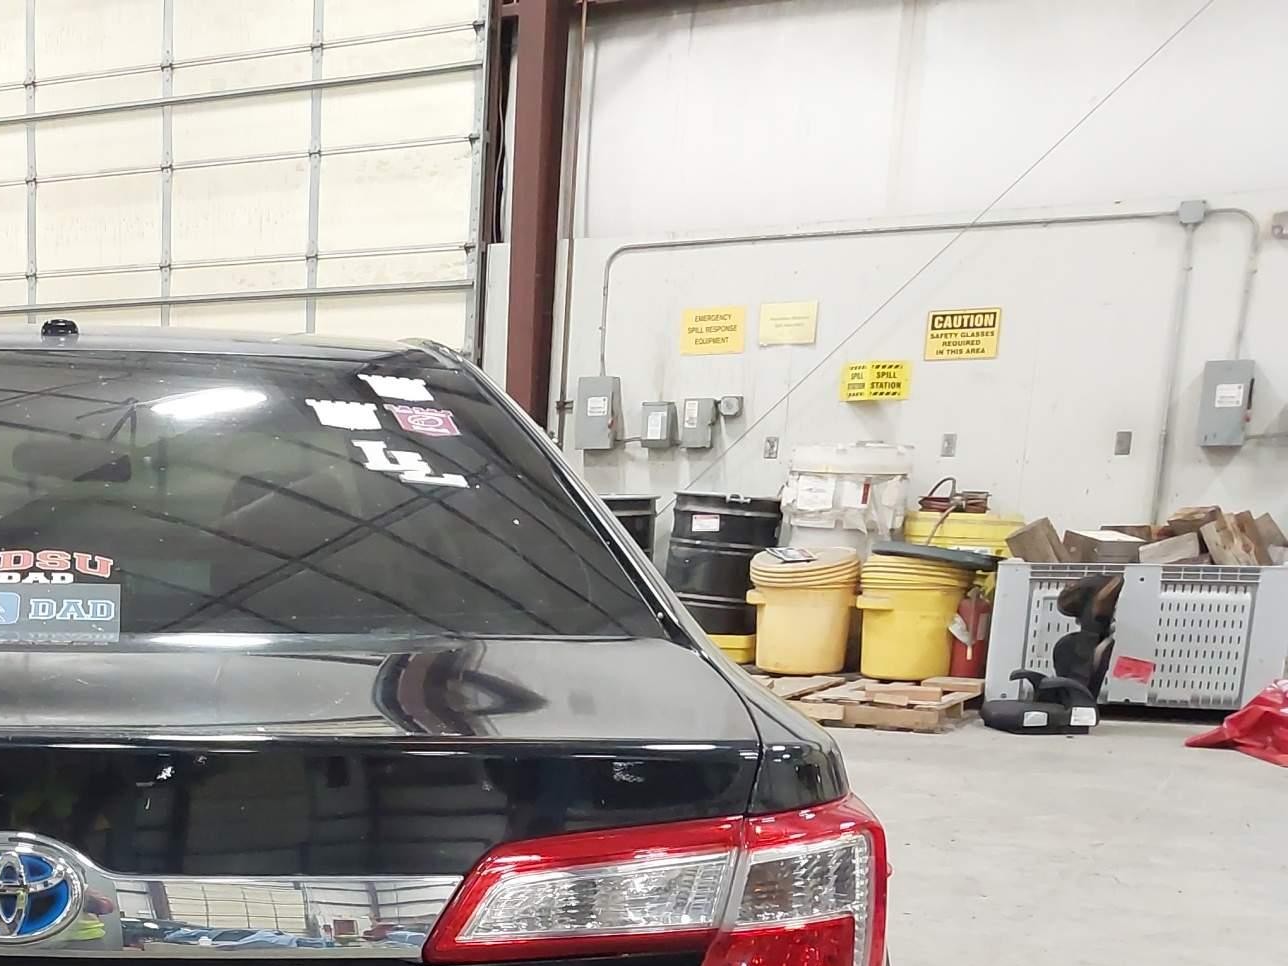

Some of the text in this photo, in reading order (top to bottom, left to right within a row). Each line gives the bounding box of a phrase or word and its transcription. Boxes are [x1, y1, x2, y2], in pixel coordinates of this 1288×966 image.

[694, 313, 732, 323] EMERGENCY
[933, 313, 995, 329] CAUTION
[687, 324, 738, 335] SPILL RESPONSE
[929, 330, 995, 340] SAFETY GLASSES
[694, 336, 730, 345] EQUIPMENT
[941, 339, 981, 347] REQUIRED
[875, 371, 897, 379] SPILL
[870, 381, 902, 389] STATION
[28, 598, 115, 621] DAD
